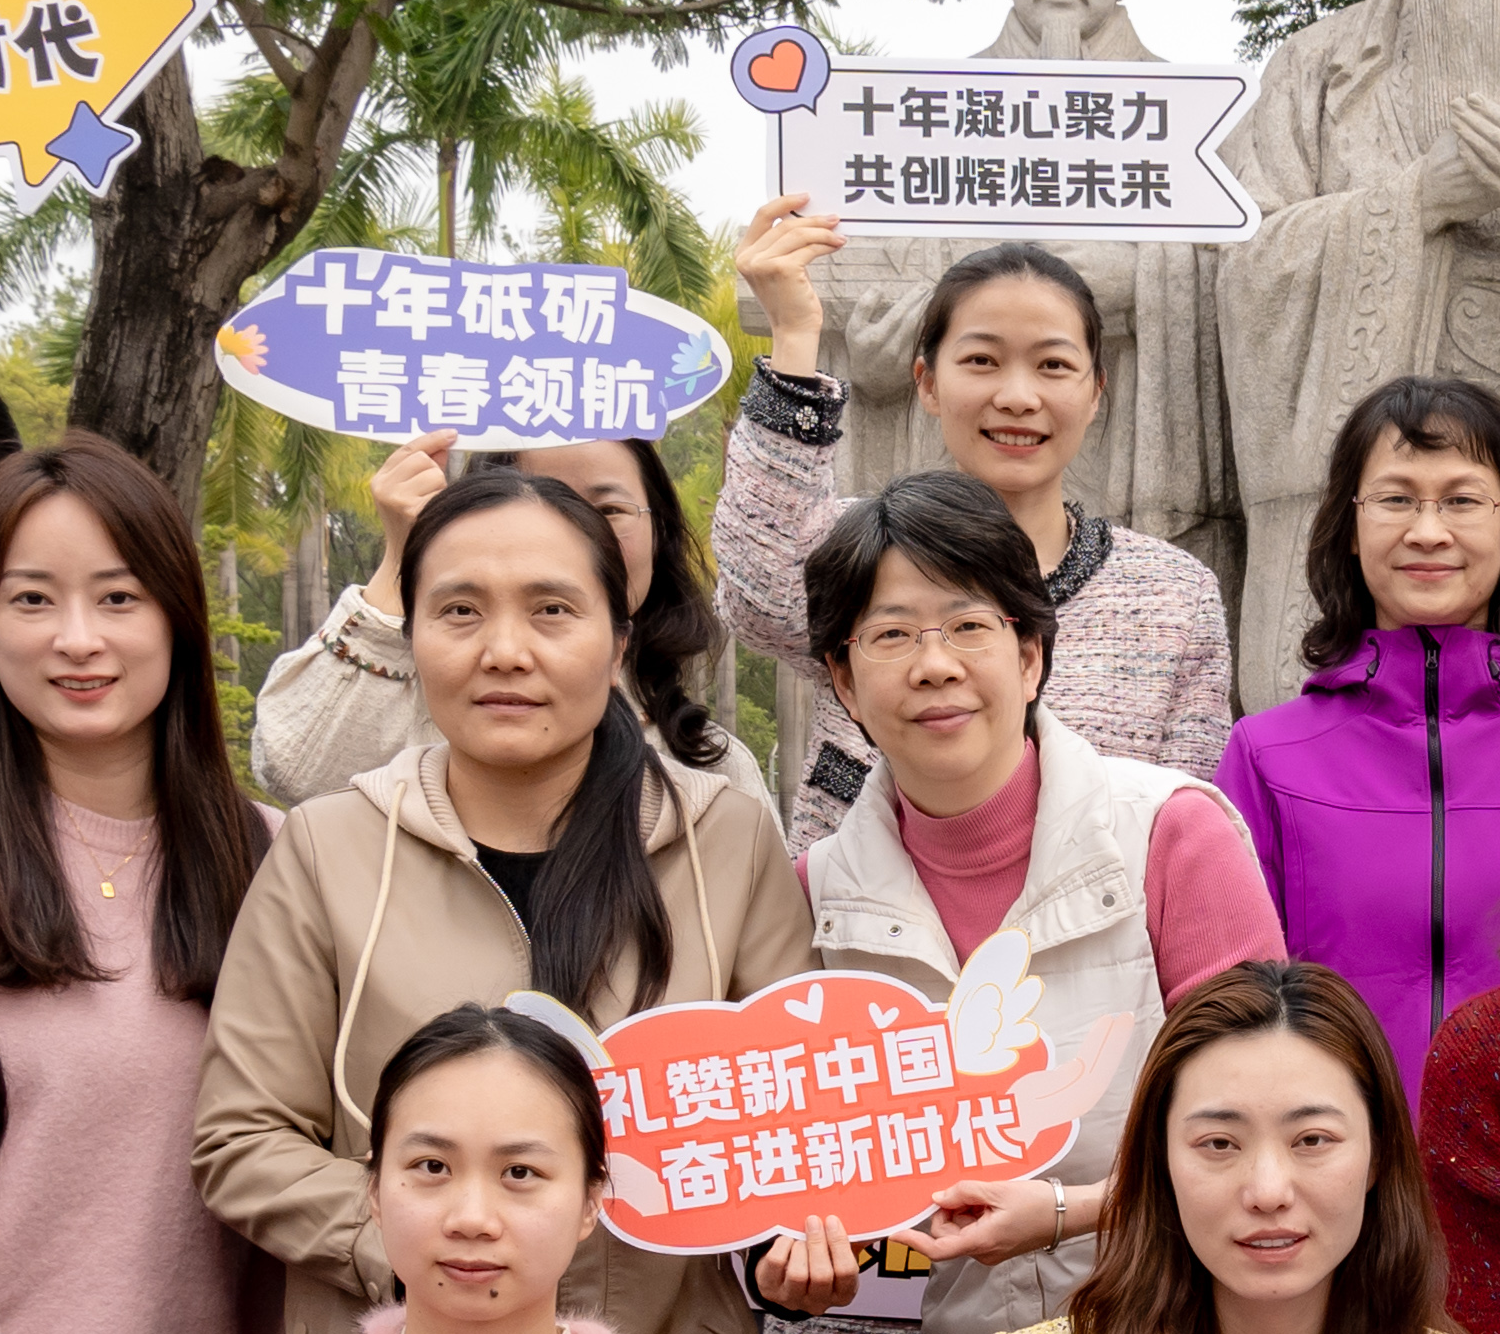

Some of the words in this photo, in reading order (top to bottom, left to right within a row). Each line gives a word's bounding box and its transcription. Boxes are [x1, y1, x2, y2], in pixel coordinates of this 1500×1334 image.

[843, 87, 1170, 143] 十年凝心聚力
[844, 154, 1172, 210] 共创辉煌未来
[295, 263, 619, 344] 十年砥砺
[336, 348, 657, 434] 青春领航
[599, 1022, 955, 1138] 礼赞新中国
[660, 1095, 1024, 1210] 奋进新时代
